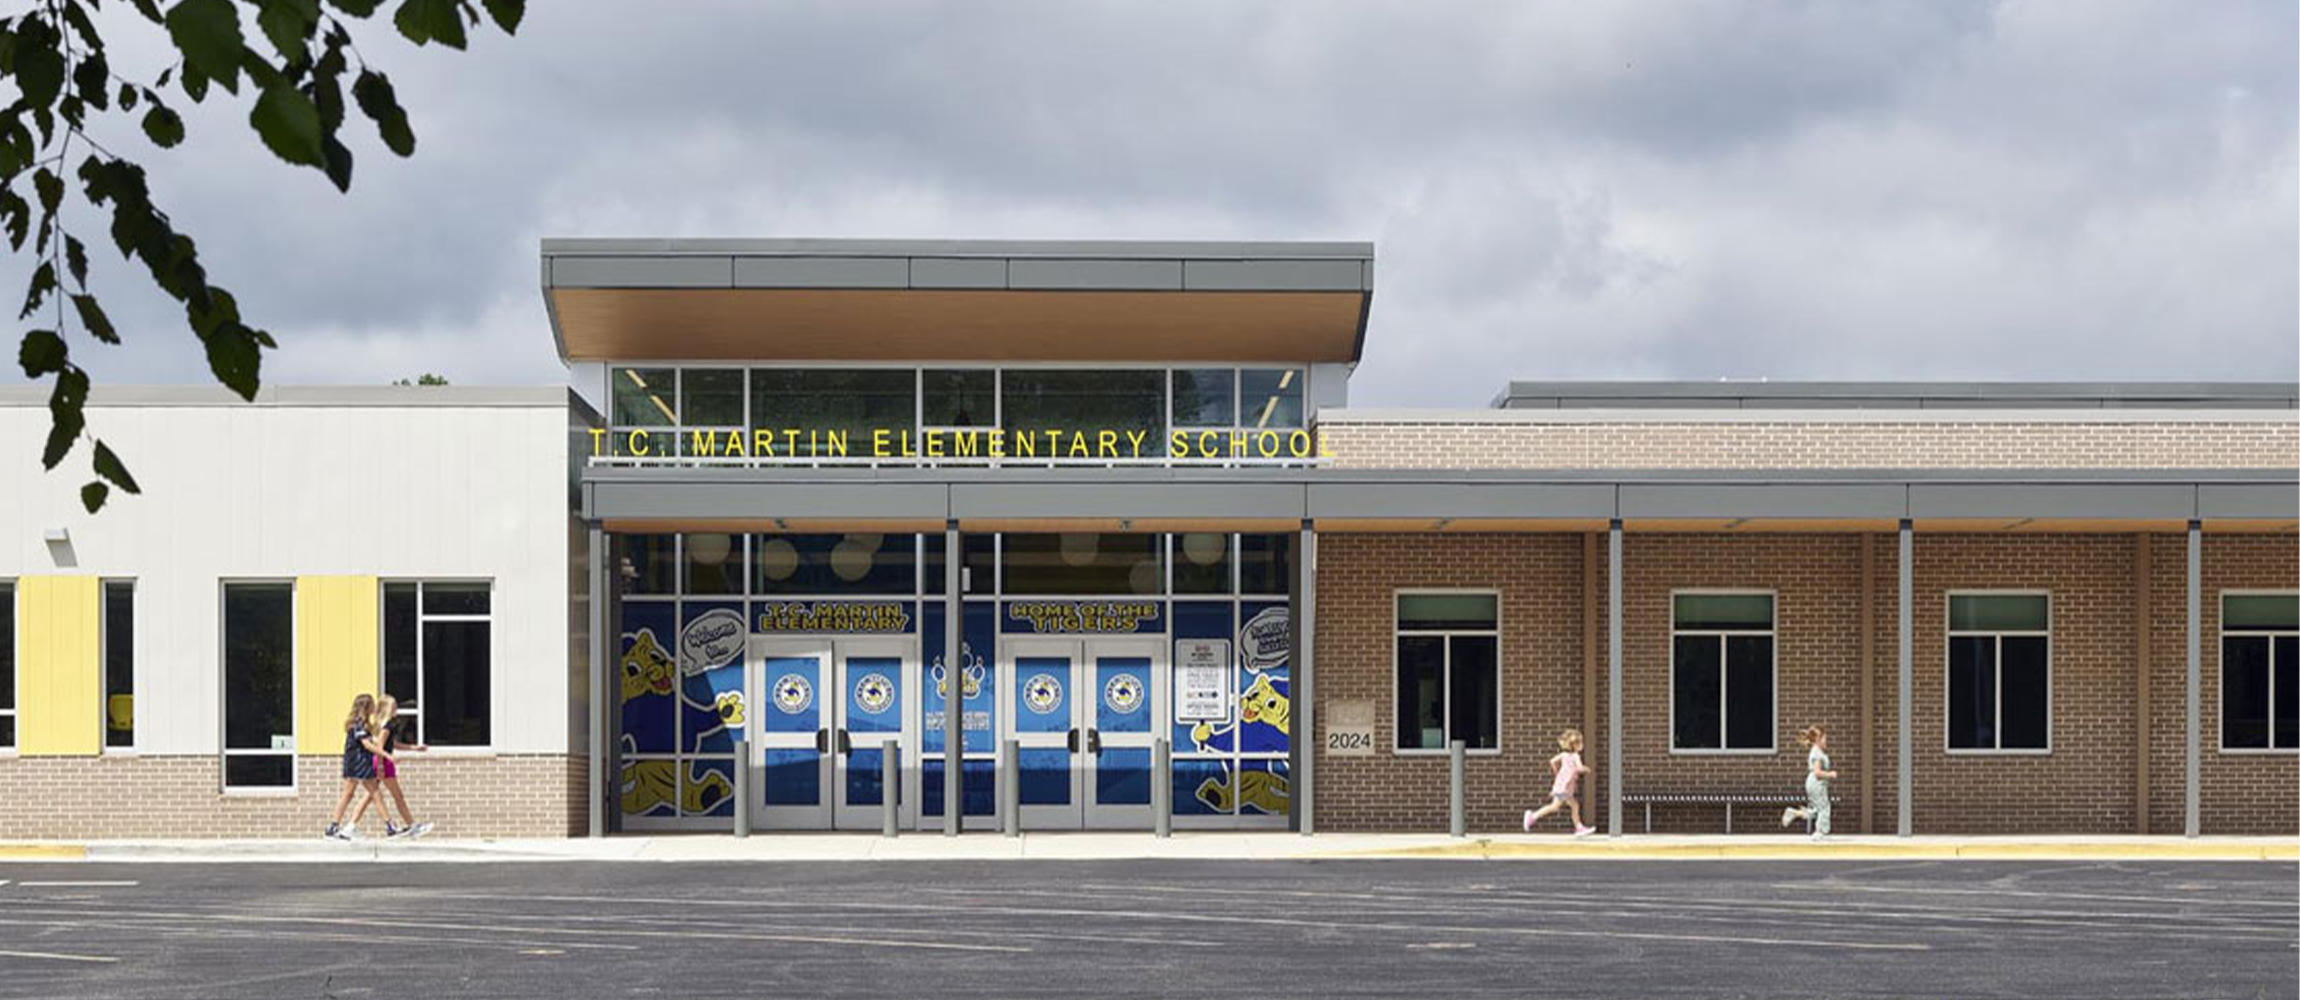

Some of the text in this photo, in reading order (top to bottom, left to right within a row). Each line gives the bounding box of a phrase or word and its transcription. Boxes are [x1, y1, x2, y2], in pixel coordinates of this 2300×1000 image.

[692, 428, 848, 457] MARTIN
[873, 429, 1147, 457] ELEMENTARY
[1171, 430, 1336, 458] SCHOOL
[815, 603, 901, 617] MARTIN
[1010, 604, 1156, 617] HOME OF THE
[761, 617, 907, 631] ELEMENTARY
[1034, 616, 1138, 630] TIGERS
[1329, 732, 1371, 749] 2024
